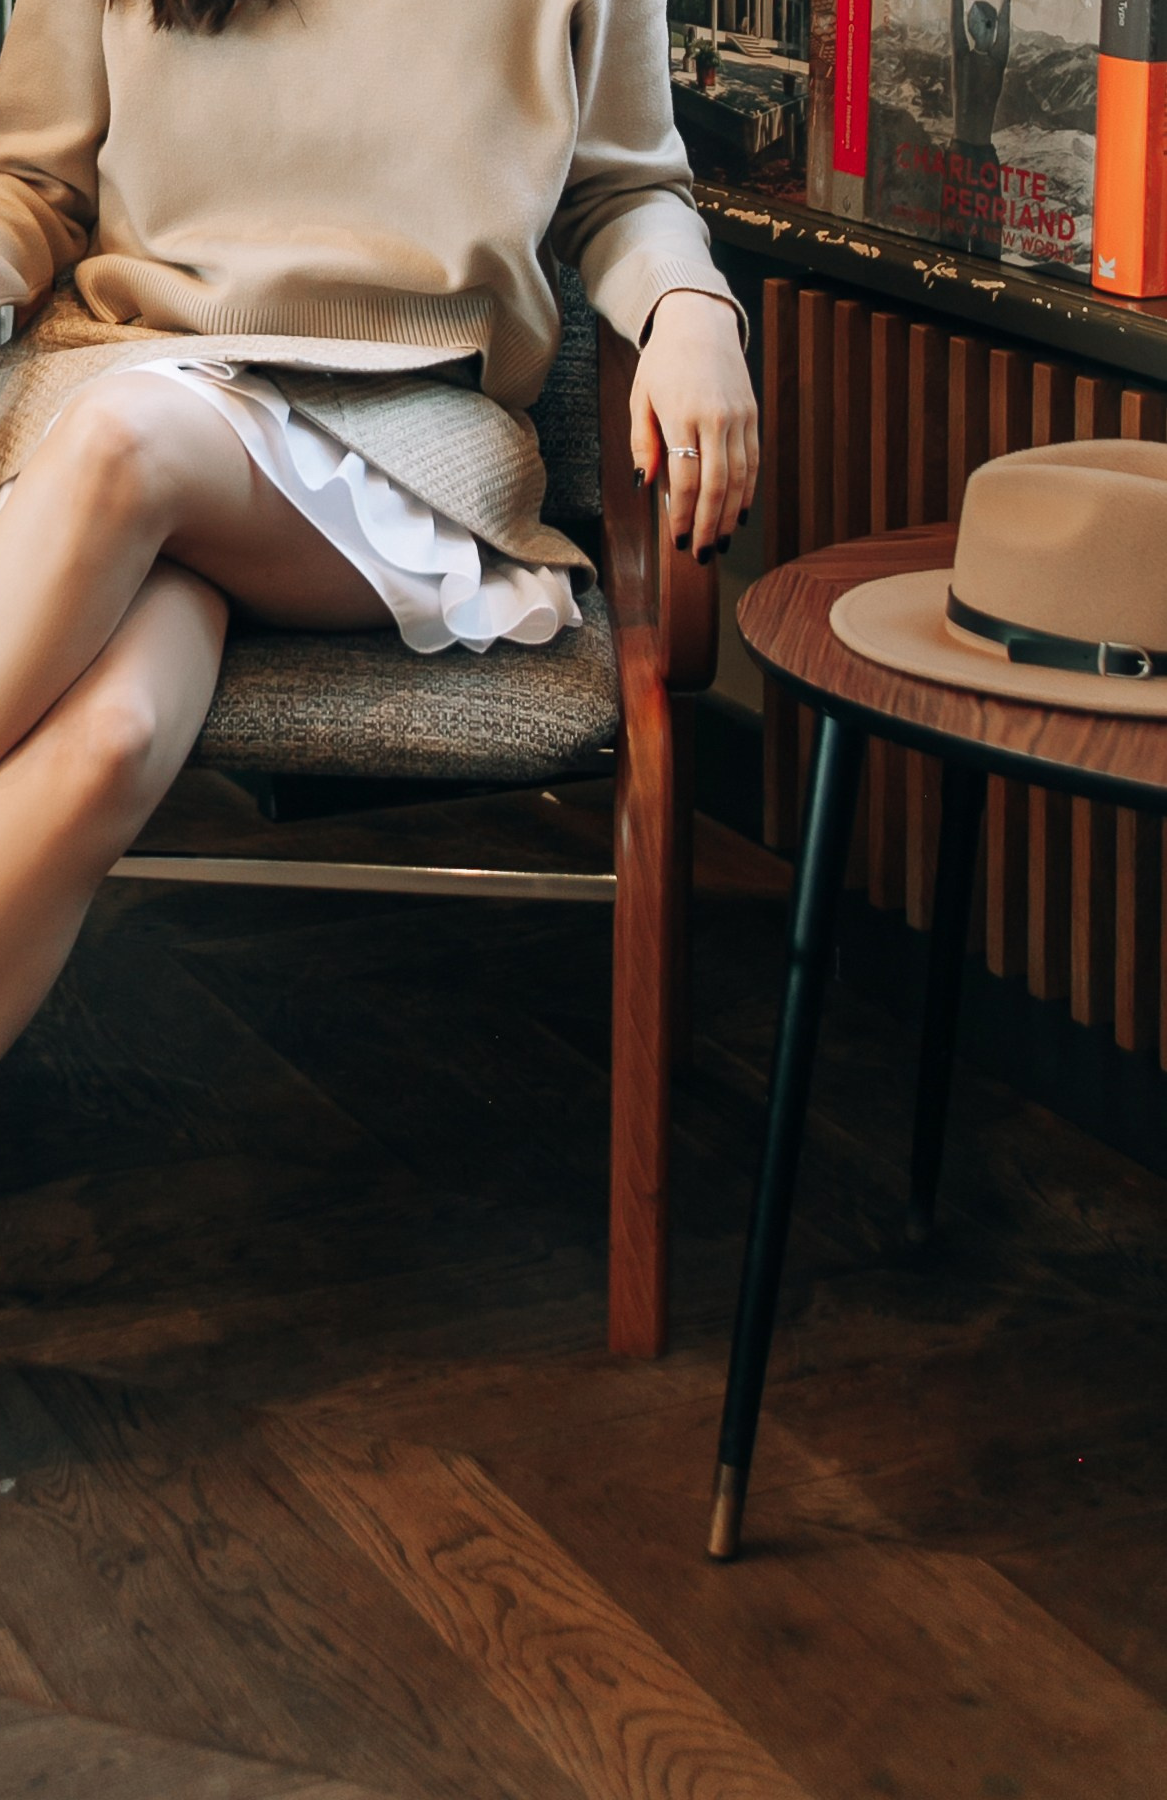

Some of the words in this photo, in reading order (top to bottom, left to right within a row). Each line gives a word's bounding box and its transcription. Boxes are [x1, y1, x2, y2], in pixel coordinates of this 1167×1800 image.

[1118, 2, 1127, 26] Type
[846, 24, 854, 101] Contemporary
[896, 143, 1047, 201] CHARLOTTE
[942, 184, 1076, 241] PERRIAND
[1020, 233, 1074, 263] WORLD
